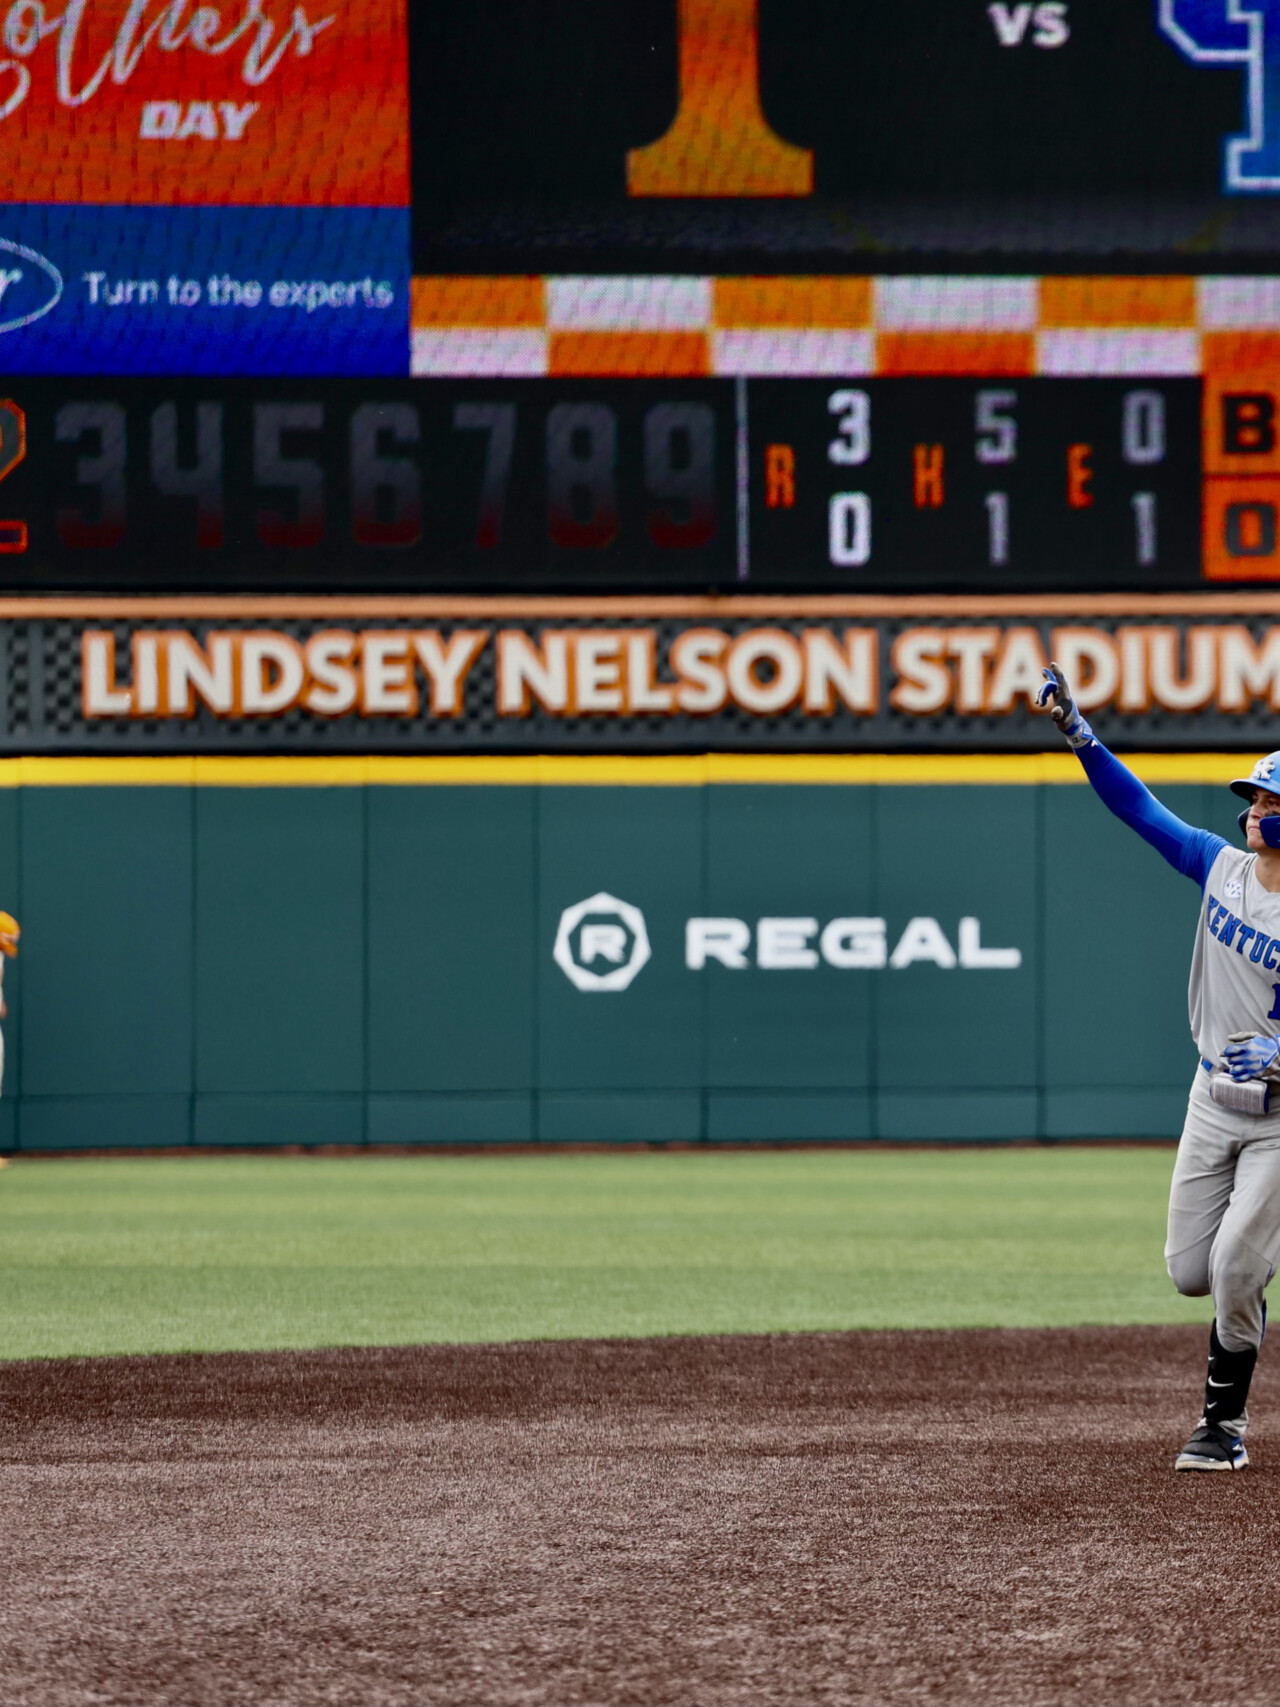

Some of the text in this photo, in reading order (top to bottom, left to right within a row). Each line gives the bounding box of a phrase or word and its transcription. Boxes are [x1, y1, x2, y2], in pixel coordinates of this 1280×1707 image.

[0, 0, 336, 112] others
[139, 101, 260, 141] DAY
[84, 270, 394, 313] Turn to the experts
[827, 389, 1164, 466] 3 5 0
[1222, 393, 1277, 456] B
[55, 402, 127, 548] 3
[149, 402, 224, 548] 4
[253, 402, 325, 548] 5
[350, 402, 422, 548] 6
[453, 402, 517, 548] 7
[546, 402, 619, 548] 8
[644, 402, 717, 548] 9
[766, 445, 1092, 507] R H E
[828, 491, 1157, 567] 0 1 1
[1222, 499, 1279, 559] 0
[82, 629, 488, 717] LINDSEY
[496, 627, 878, 715] NELSON
[685, 916, 1022, 970] REGAL
